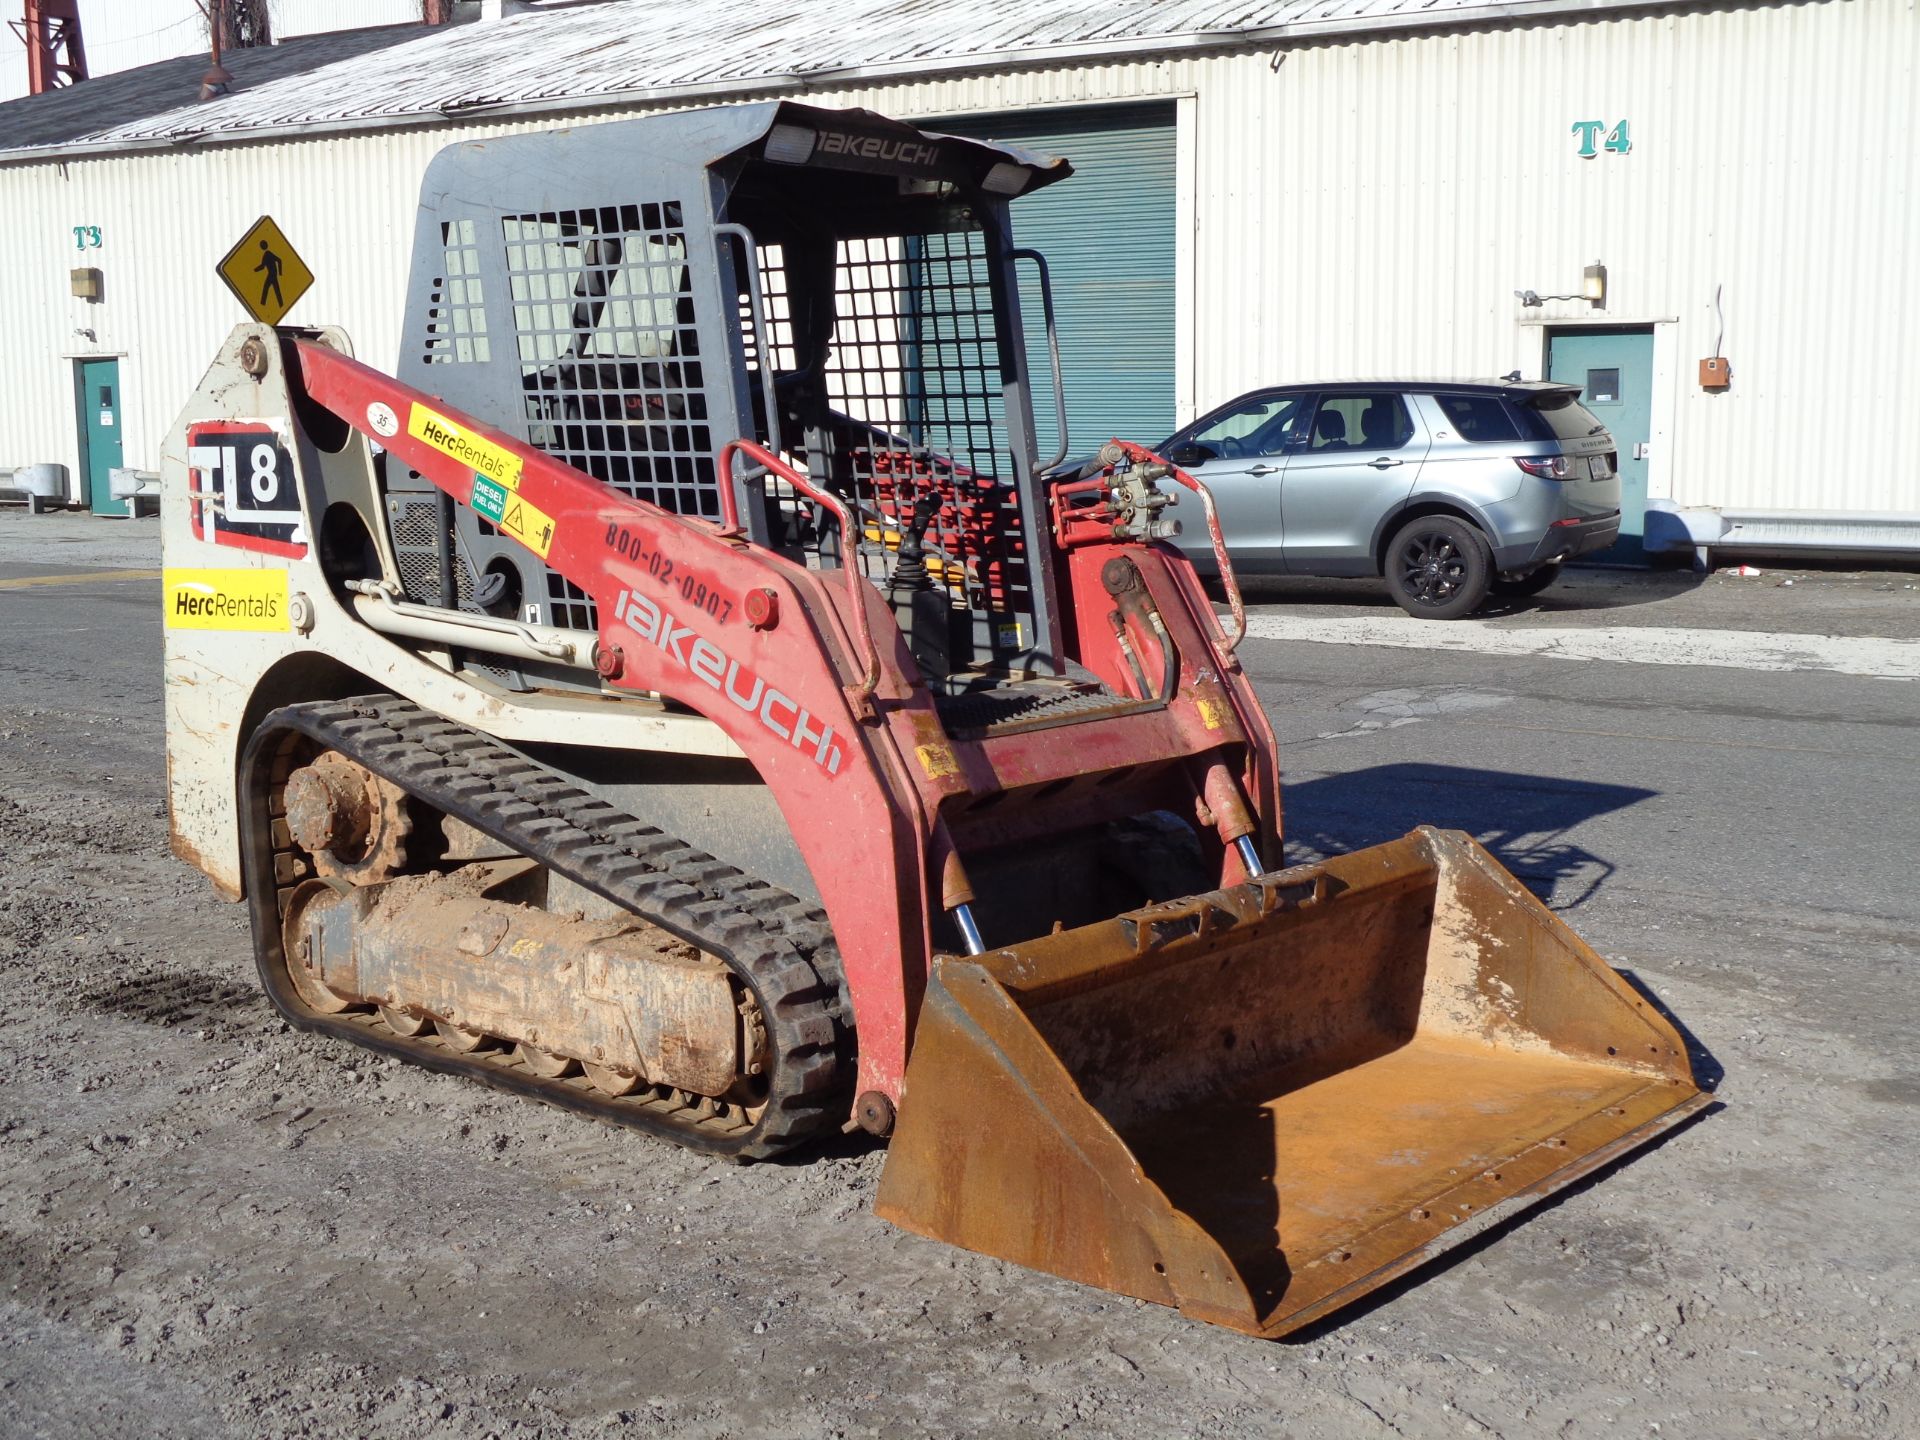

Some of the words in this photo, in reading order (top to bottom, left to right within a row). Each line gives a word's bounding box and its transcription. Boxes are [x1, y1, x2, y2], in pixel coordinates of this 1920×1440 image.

[1571, 119, 1630, 158] T4
[73, 225, 101, 250] T3
[423, 421, 505, 477] HercRentals
[473, 493, 487, 507] FUEL
[487, 501, 502, 514] ONLY
[476, 481, 503, 505] DIESEL
[606, 522, 733, 625] 800-02-0907
[176, 592, 277, 617] HercRentals
